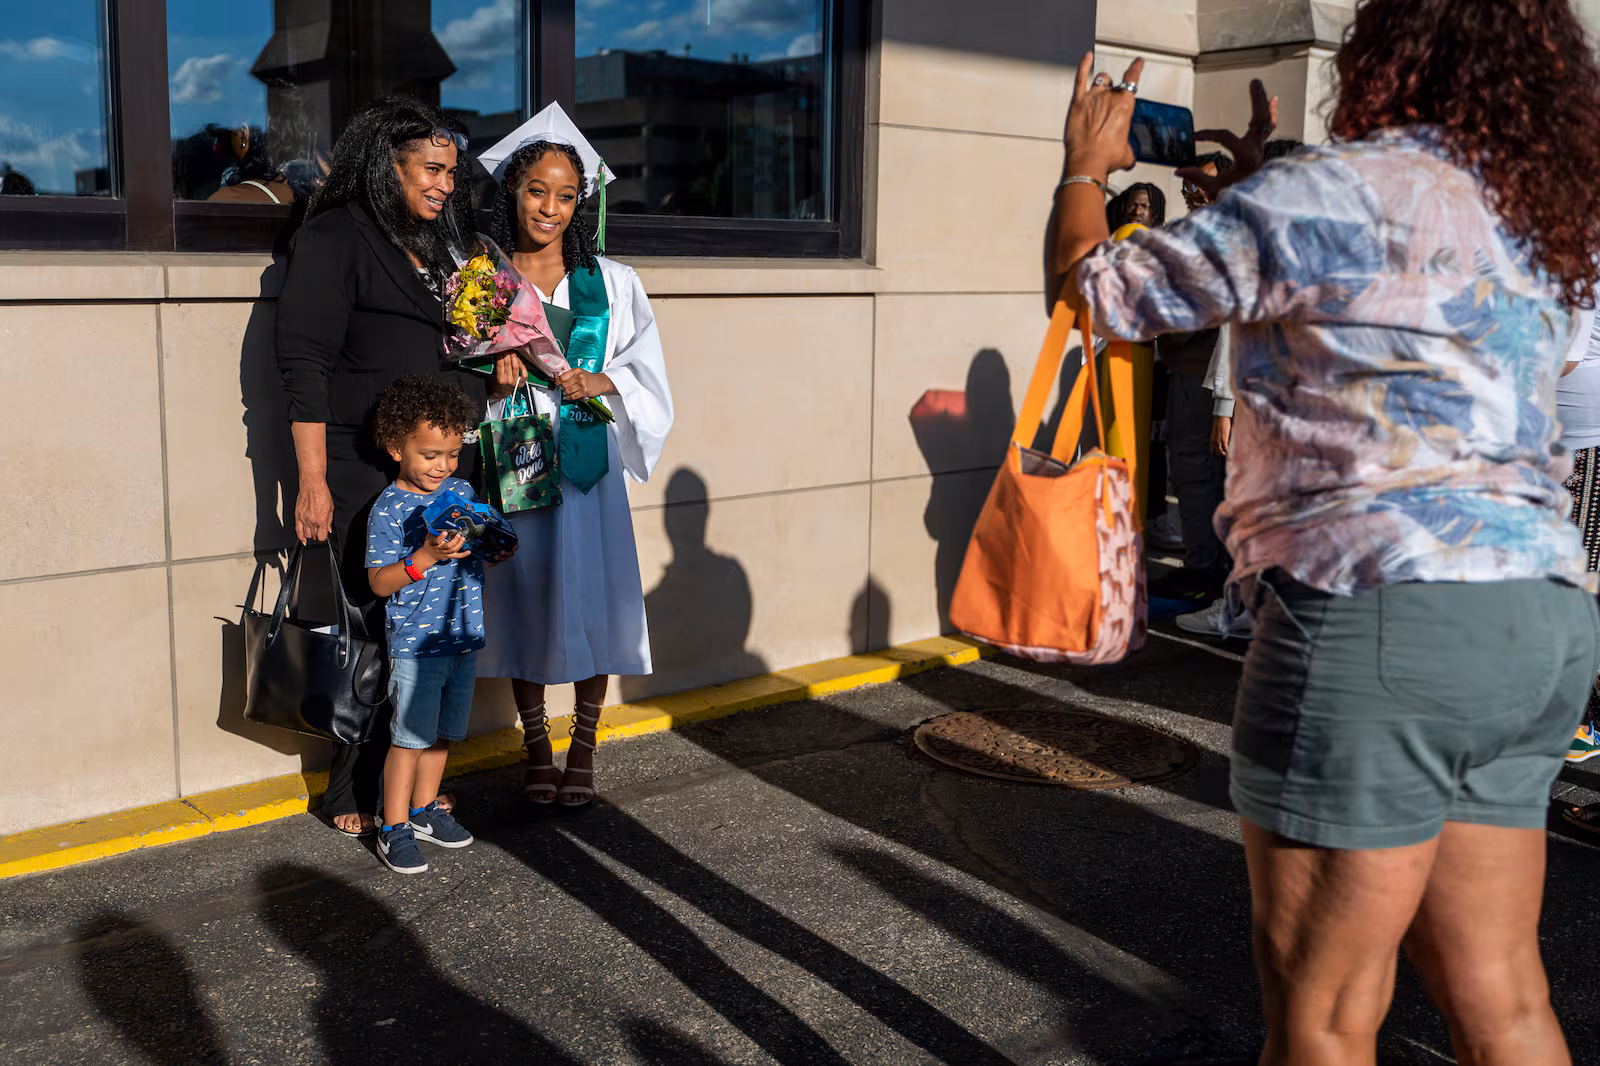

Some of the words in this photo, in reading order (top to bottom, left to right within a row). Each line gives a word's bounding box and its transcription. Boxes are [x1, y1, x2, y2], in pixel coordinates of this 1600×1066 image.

[570, 410, 594, 422] 2024
[515, 442, 541, 466] Well
[518, 458, 543, 485] Done
